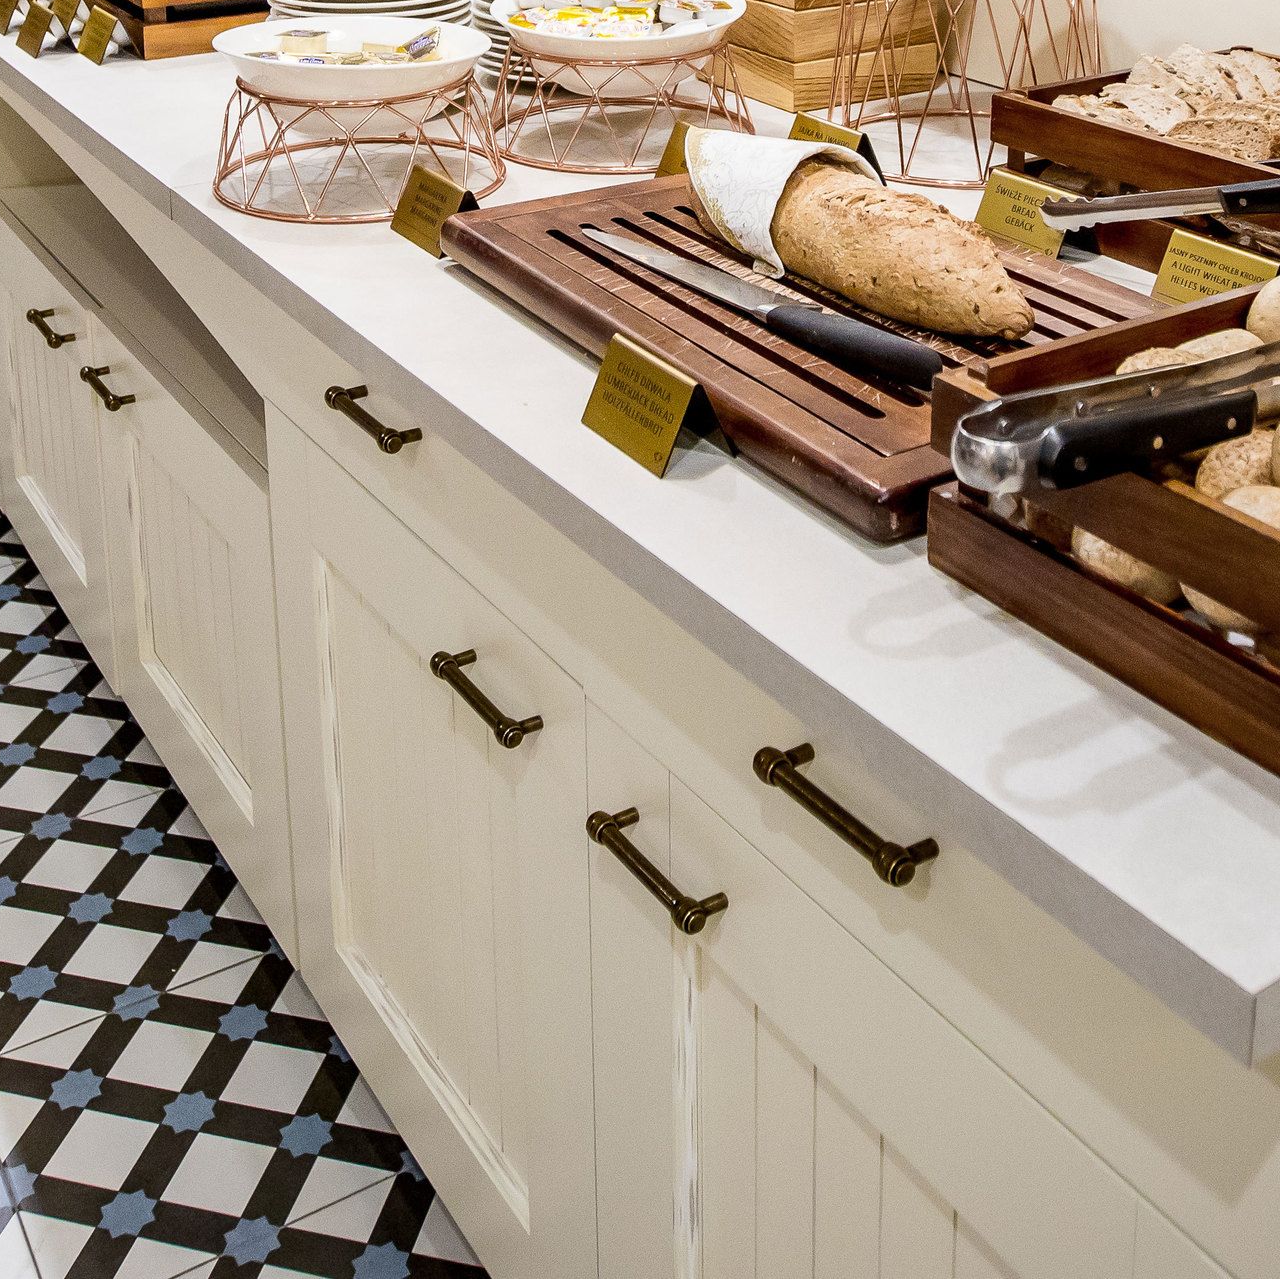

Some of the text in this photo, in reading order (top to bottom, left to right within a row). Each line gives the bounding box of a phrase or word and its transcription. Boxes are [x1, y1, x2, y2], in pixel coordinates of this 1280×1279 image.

[995, 184, 1022, 200] ŚWIEŻE
[1011, 204, 1037, 219] BREAD
[1168, 246, 1189, 258] JASNY
[1188, 253, 1219, 269] PSZENNY
[1218, 263, 1240, 276] CHLEB
[1170, 274, 1223, 296] HELLES WEIZ
[1171, 260, 1178, 269] A
[1179, 262, 1202, 277] LIGHT
[1203, 270, 1231, 287] WHEAT
[639, 376, 672, 404] DRWALA
[648, 401, 675, 425] BREAD
